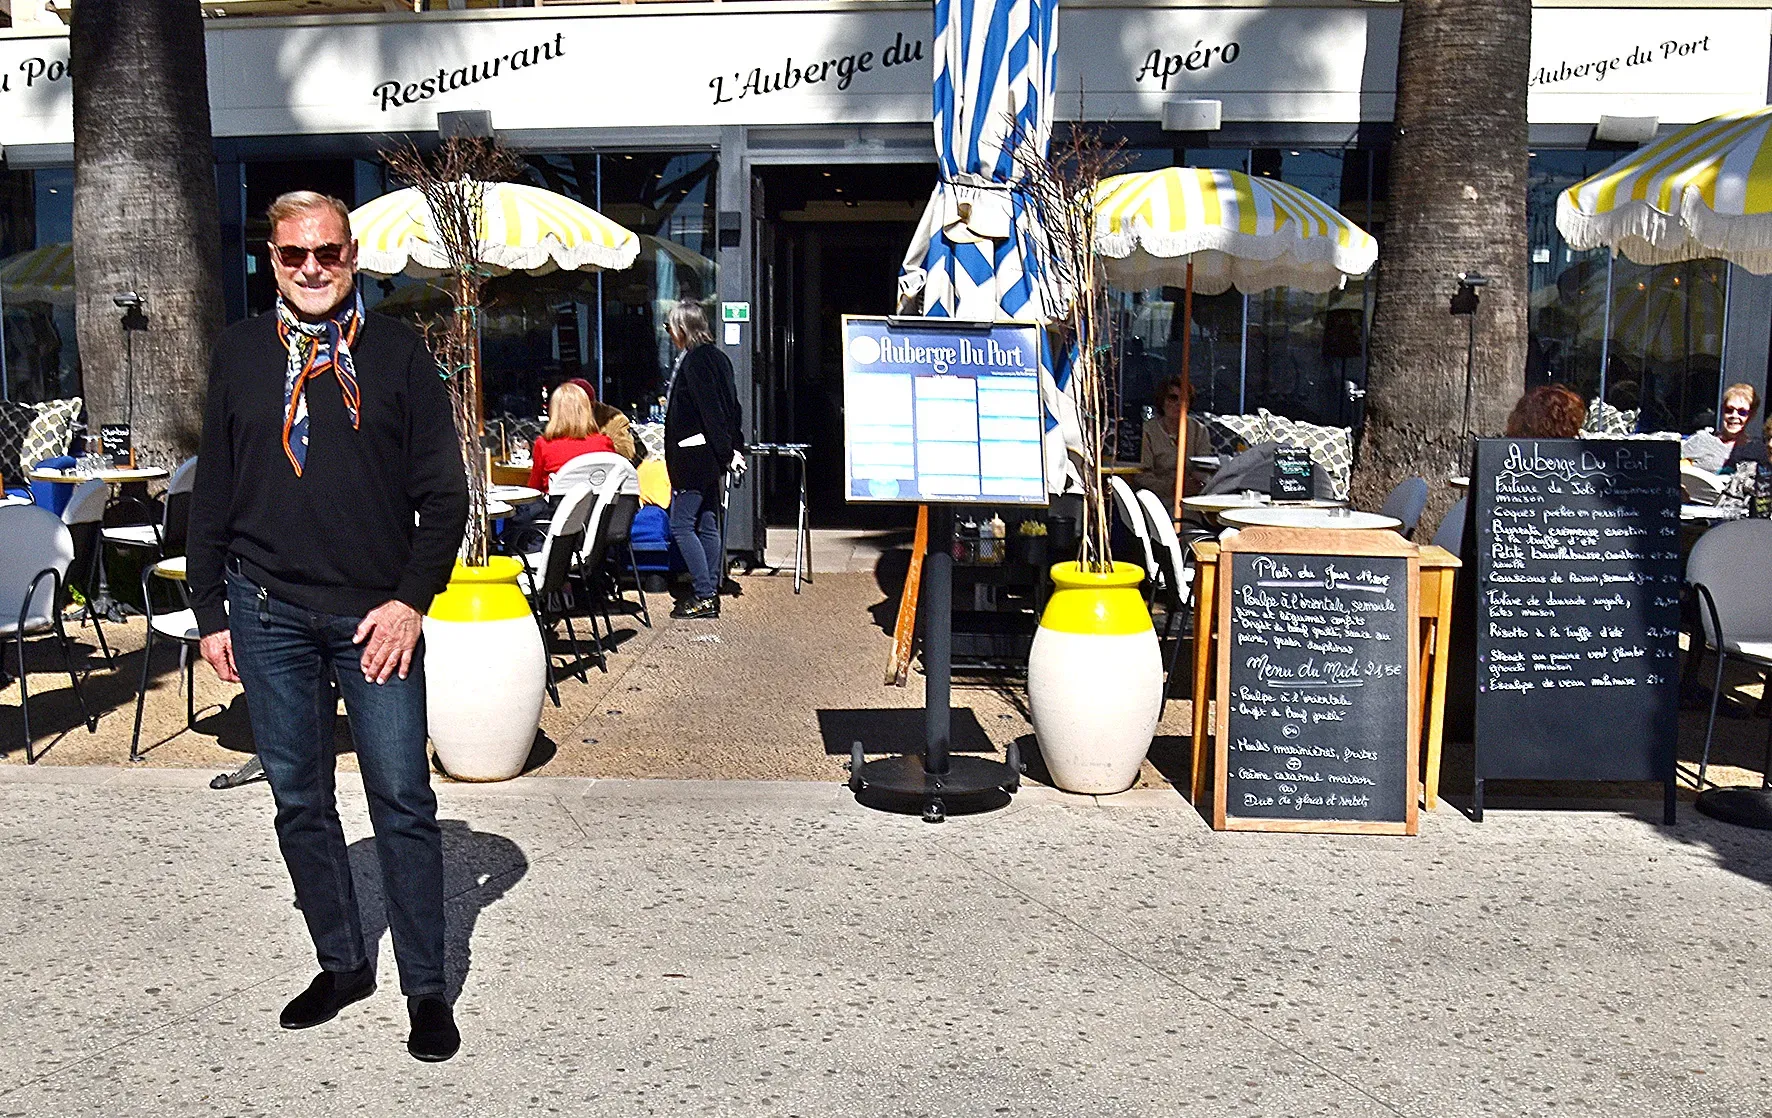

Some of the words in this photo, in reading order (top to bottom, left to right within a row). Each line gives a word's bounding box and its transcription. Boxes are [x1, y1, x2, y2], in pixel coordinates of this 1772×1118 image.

[709, 57, 874, 105] L'Auberge
[882, 32, 924, 67] du
[1135, 39, 1240, 90] Apéro
[1528, 60, 1620, 86] Auberge
[1626, 45, 1653, 67] du
[1659, 35, 1711, 59] Port
[372, 32, 566, 112] Restaurant
[880, 336, 957, 374] Auberge
[959, 338, 984, 366] Du
[987, 339, 1025, 368] Port
[1503, 442, 1577, 481] Auberge
[1581, 451, 1606, 471] Du
[1615, 448, 1654, 471] Port
[1547, 480, 1565, 494] de
[1495, 494, 1545, 503] maison
[1493, 505, 1536, 523] Coques
[1508, 534, 1522, 544] la
[1491, 542, 1527, 560] Petite
[1297, 564, 1316, 579] du
[1489, 570, 1547, 583] Couscous
[1549, 570, 1564, 584] de
[1242, 585, 1279, 609] Poulpe
[1351, 598, 1396, 613] semoule
[1486, 588, 1523, 606] Tartare
[1526, 594, 1541, 606] de
[1545, 590, 1587, 606] daurade
[1262, 611, 1276, 621] et
[1330, 615, 1366, 629] confits
[1521, 608, 1556, 618] maison
[1273, 622, 1286, 632] de
[1343, 629, 1373, 639] sauce
[1375, 632, 1392, 641] au
[1489, 621, 1529, 638] Risotto
[1550, 625, 1561, 638] la
[1531, 653, 1547, 661] au
[1587, 646, 1609, 660] vert
[1246, 653, 1294, 681] Menu
[1297, 657, 1321, 678] du
[1323, 659, 1361, 683] Midi
[1533, 662, 1573, 671] maison
[1489, 677, 1536, 695] Escalope
[1541, 676, 1556, 688] de
[1558, 679, 1586, 688] veau
[1239, 685, 1277, 705] Poulpe
[1270, 707, 1282, 717] de
[1236, 738, 1271, 752] Moules
[1344, 746, 1378, 763] frites
[1274, 771, 1324, 783] caramel
[1328, 774, 1376, 786] maison
[1243, 793, 1274, 807] Duo
[1278, 795, 1291, 805] de
[1325, 794, 1338, 806] et
[1338, 795, 1370, 807] sorbets
